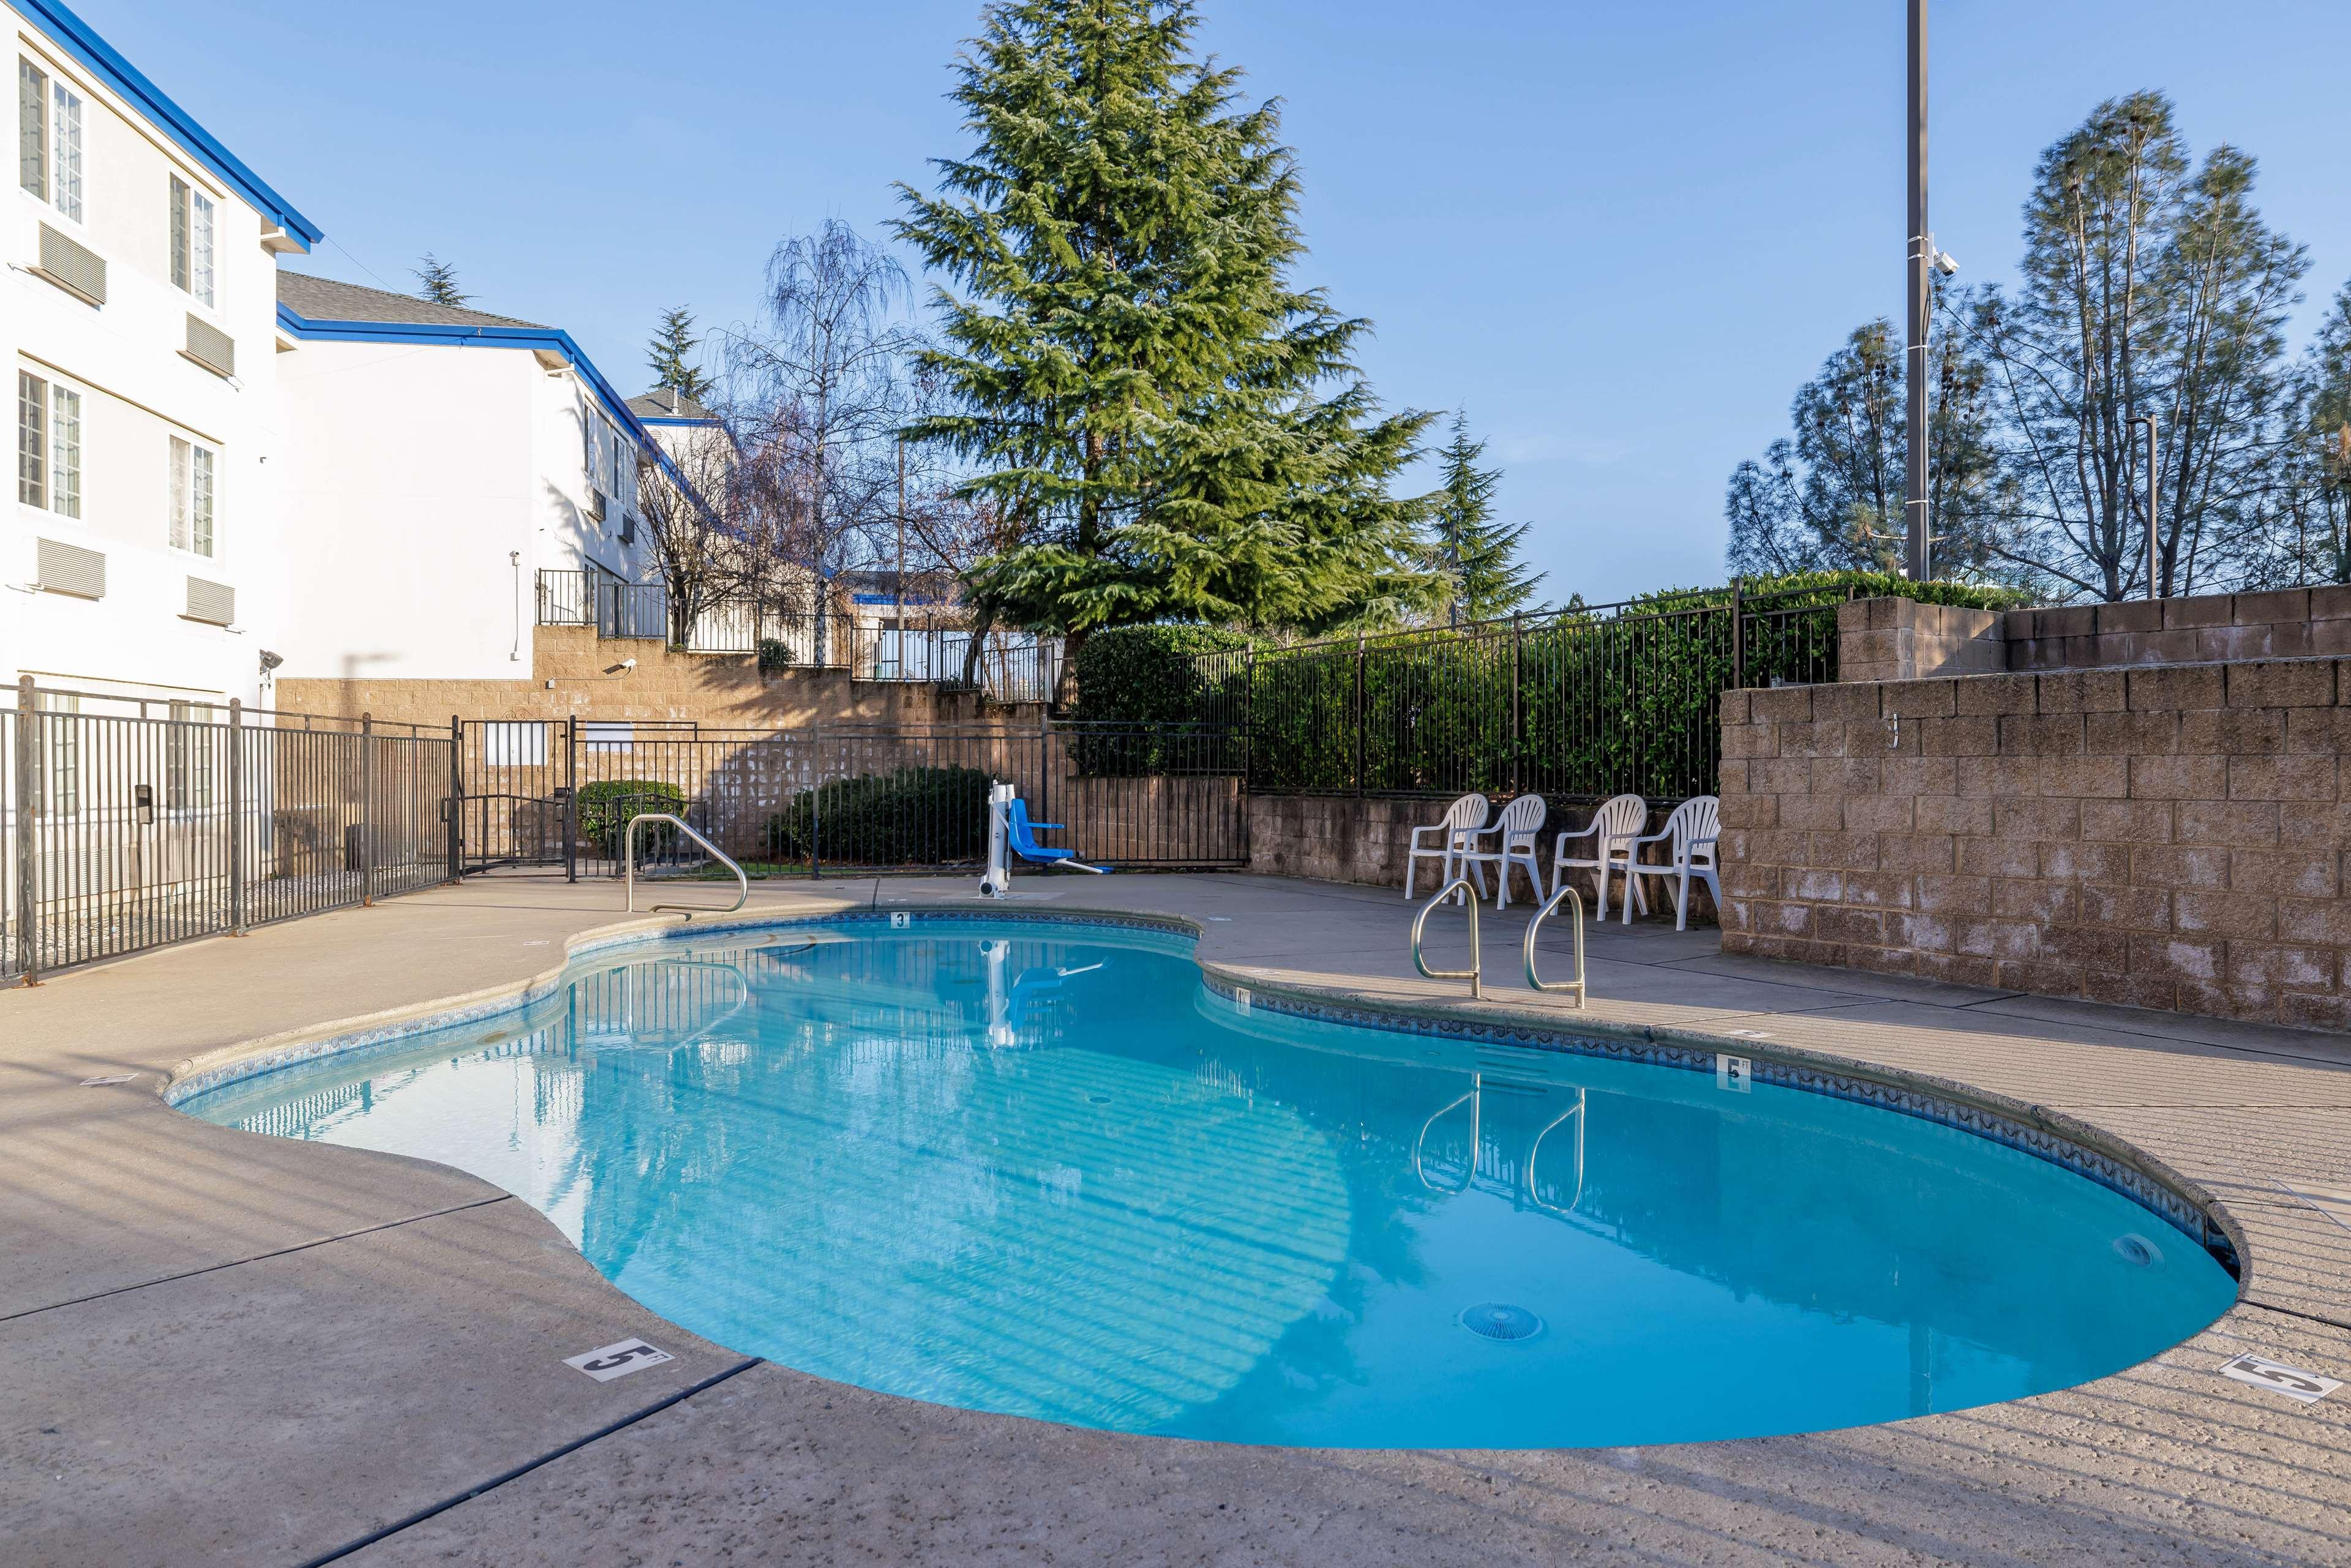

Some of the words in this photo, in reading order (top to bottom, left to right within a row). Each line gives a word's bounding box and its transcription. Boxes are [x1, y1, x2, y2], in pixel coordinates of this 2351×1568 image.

[1728, 1058, 1739, 1078] 5
[1742, 1060, 1749, 1070] FT
[583, 1346, 657, 1371] 5
[647, 1354, 669, 1362] FT
[2232, 1360, 2323, 1392] 5
